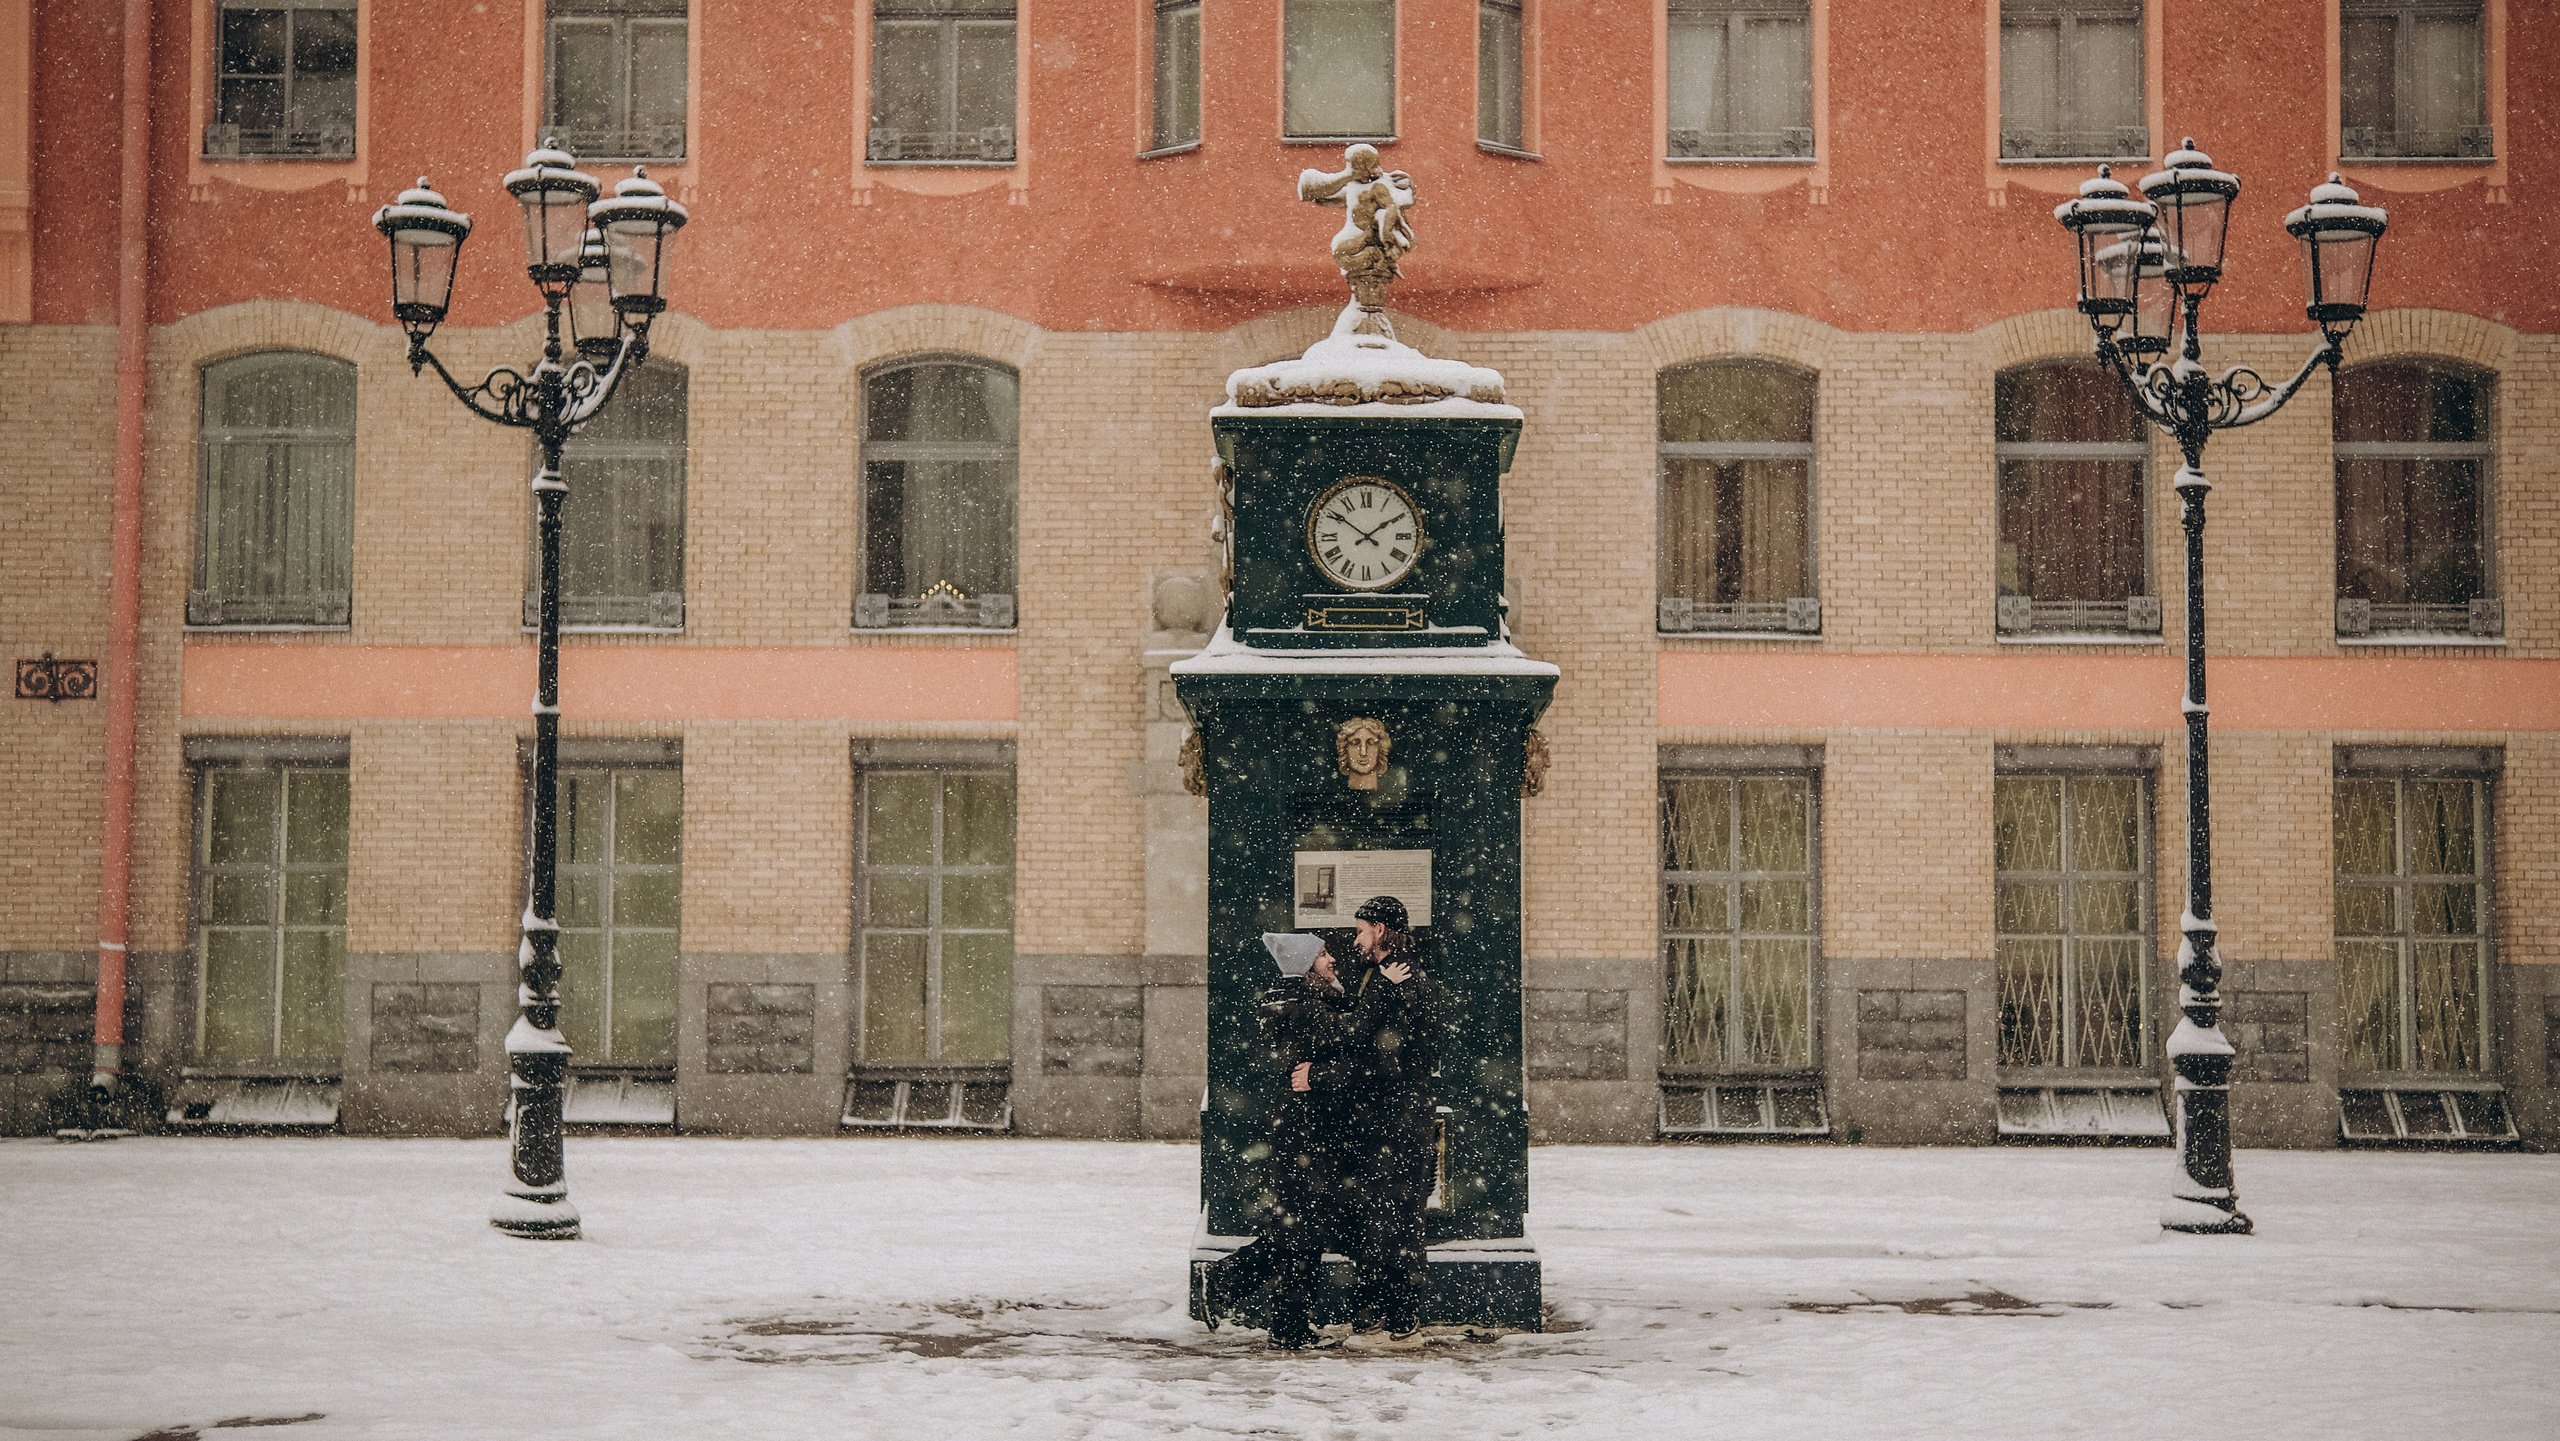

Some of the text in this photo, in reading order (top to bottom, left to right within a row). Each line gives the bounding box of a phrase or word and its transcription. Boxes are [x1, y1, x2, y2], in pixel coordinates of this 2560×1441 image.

[1340, 497, 1356, 514] XI
[1360, 491, 1372, 508] XII
[1321, 532, 1338, 542] IX
[1395, 532, 1411, 541] III
[1324, 545, 1343, 565] VIII
[1339, 559, 1355, 578] VII
[1361, 565, 1371, 581] VI
[1380, 561, 1391, 575] V
